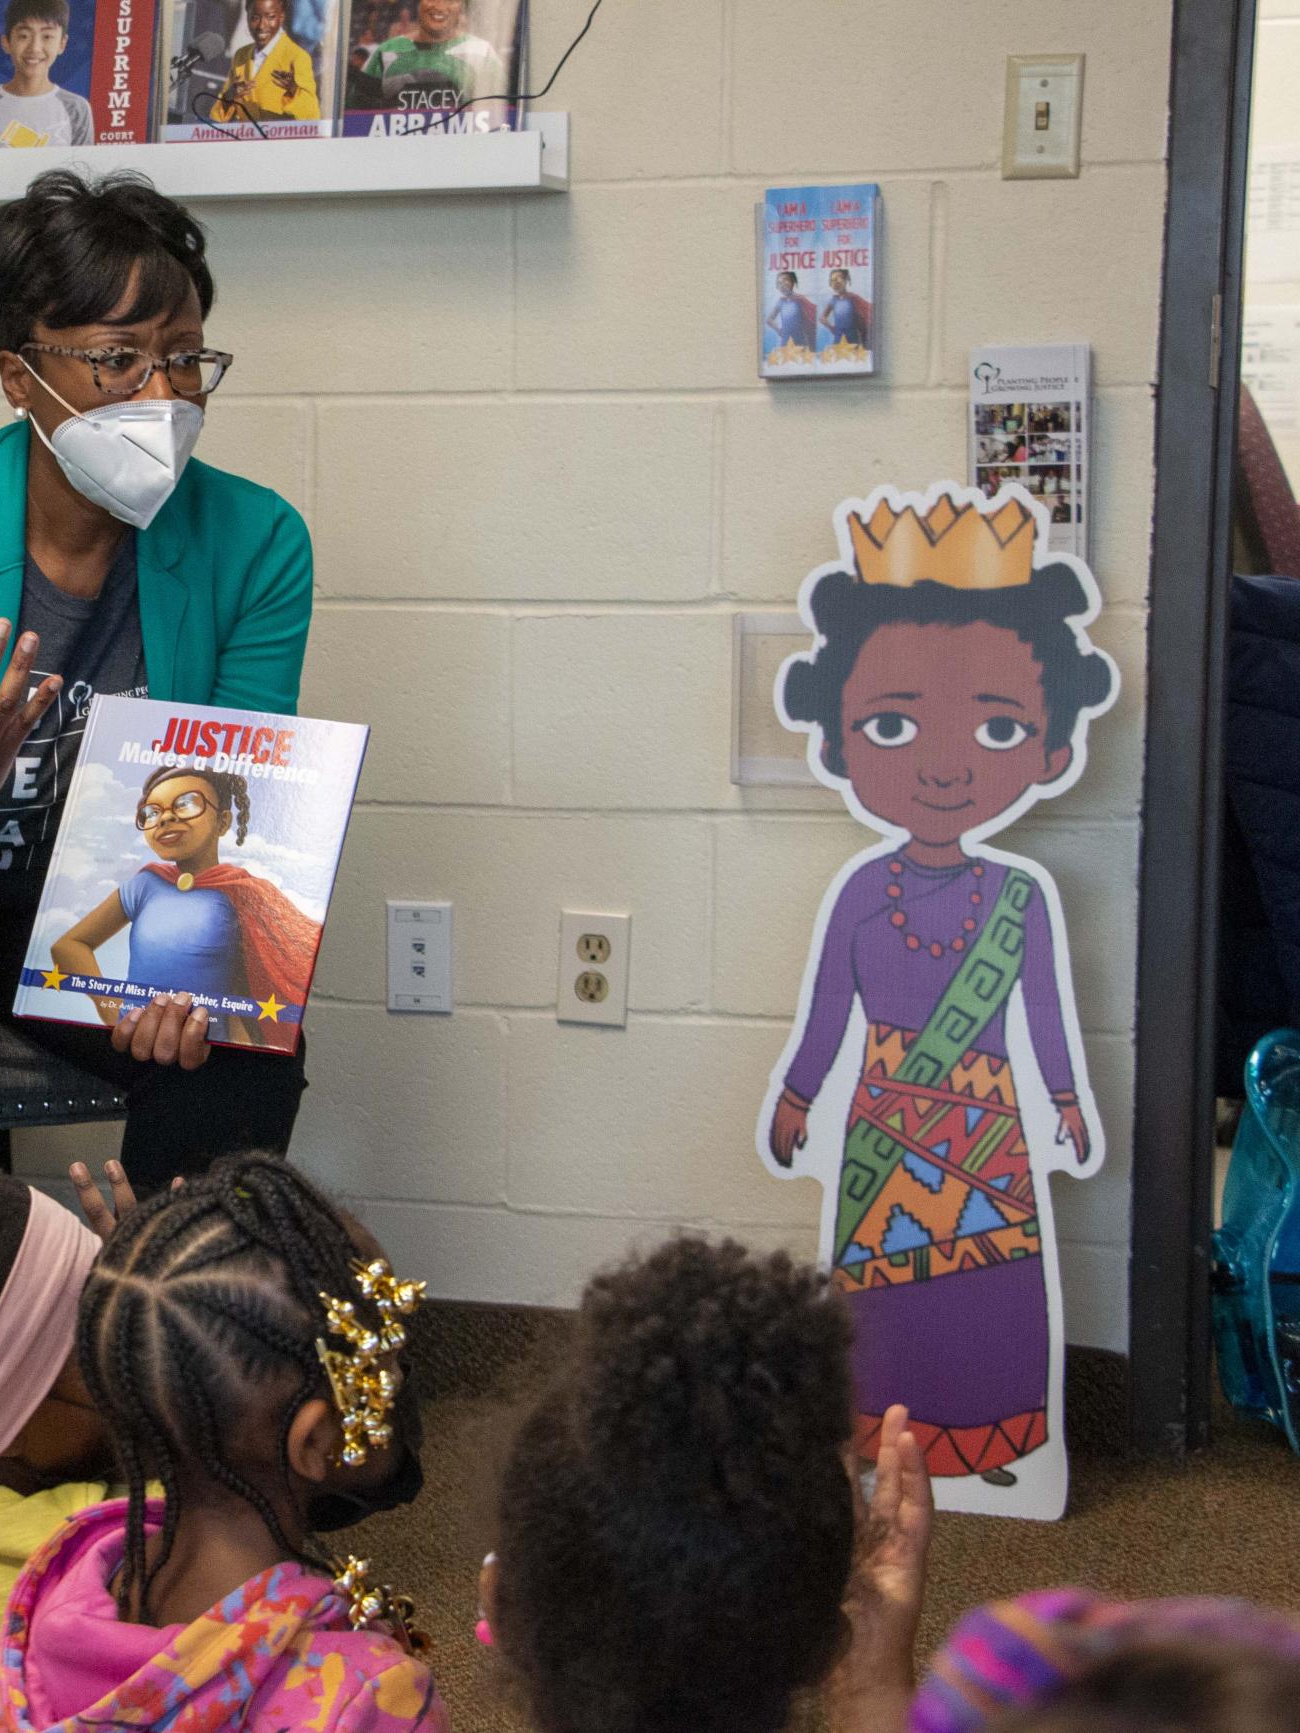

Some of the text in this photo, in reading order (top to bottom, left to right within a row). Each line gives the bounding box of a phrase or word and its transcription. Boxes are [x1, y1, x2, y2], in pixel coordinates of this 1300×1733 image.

[108, 0, 132, 127] SUPREME
[398, 89, 464, 110] STACEY
[191, 123, 319, 140] Amanda Gorman
[368, 111, 490, 137] ABRAMS
[100, 131, 134, 140] COURT
[768, 251, 816, 271] JUSTICE
[821, 249, 869, 268] JUSTICE
[152, 717, 296, 767] JUSTICE
[118, 741, 319, 786] Makes a Difference
[71, 976, 86, 988] The
[88, 979, 112, 994] Story
[113, 981, 124, 993] of
[125, 984, 146, 997] Miss
[221, 997, 253, 1013] Esquire
[108, 1000, 118, 1009] Dr.
